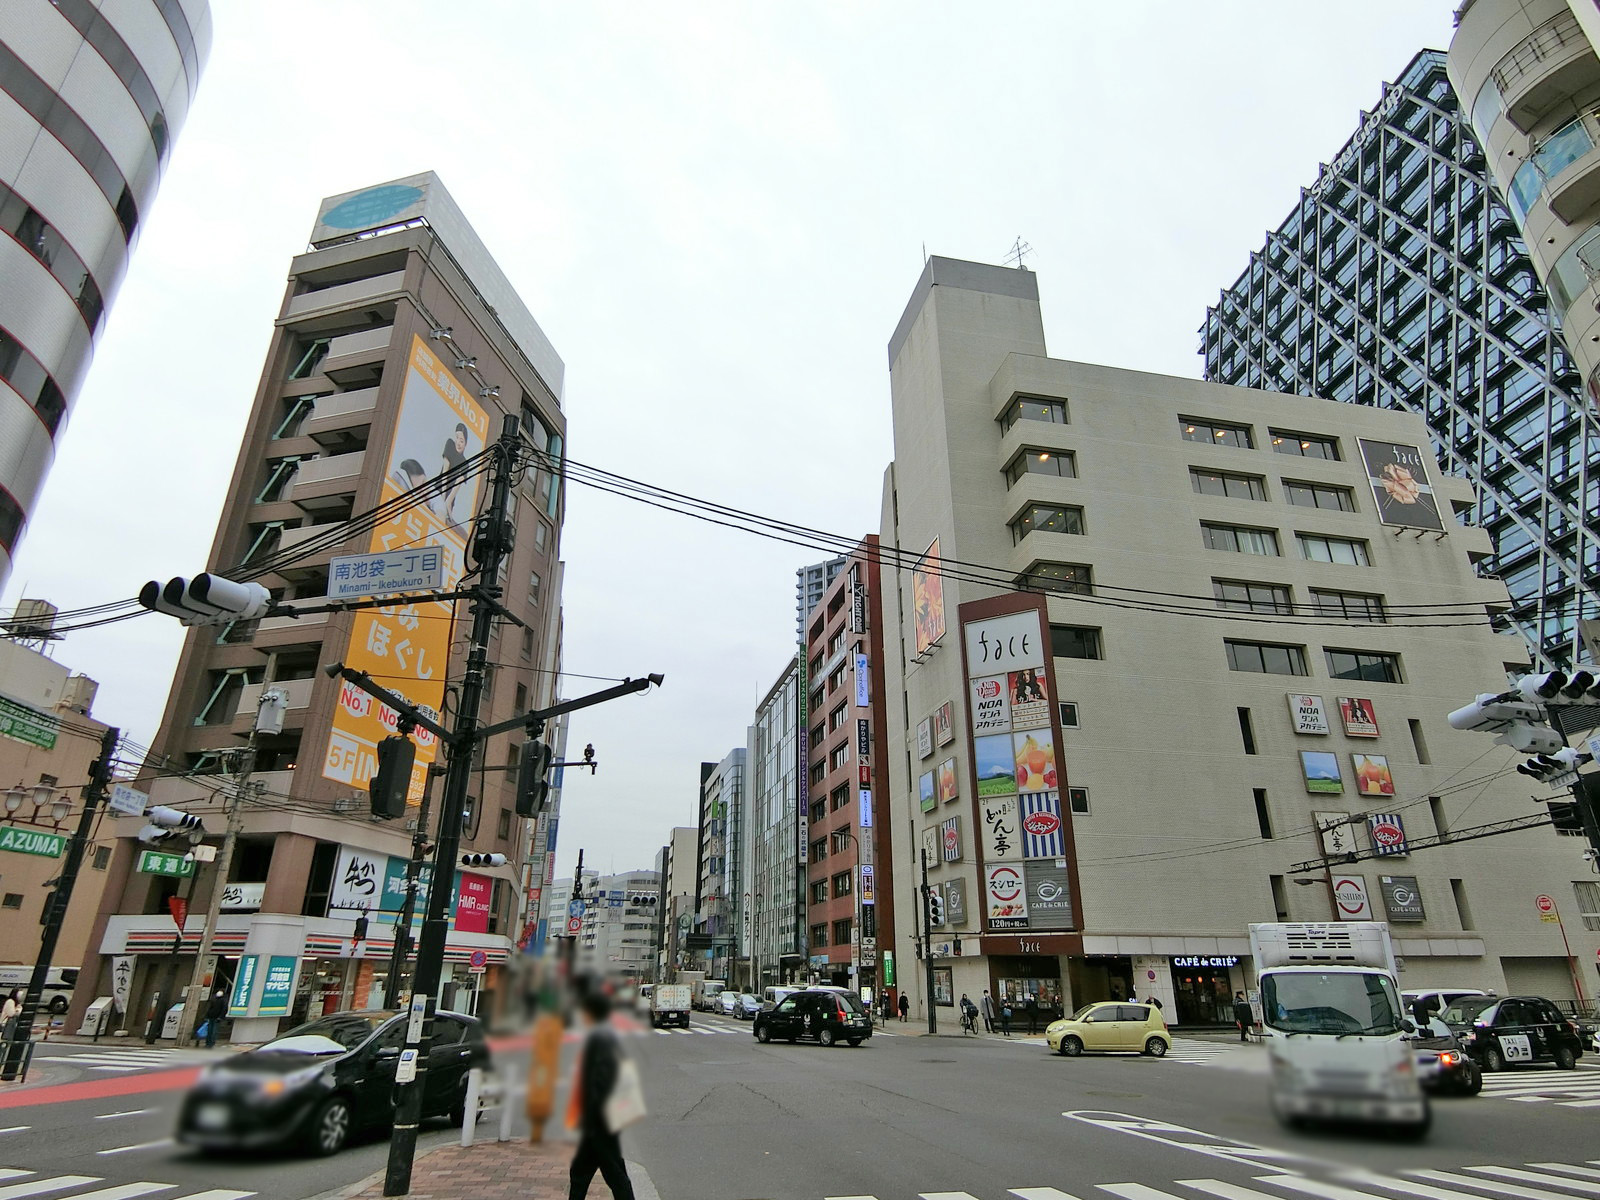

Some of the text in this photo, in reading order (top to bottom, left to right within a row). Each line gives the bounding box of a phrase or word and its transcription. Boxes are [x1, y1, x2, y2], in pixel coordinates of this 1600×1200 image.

[1311, 84, 1404, 201] Seibu Group
[1392, 446, 1420, 466] face
[335, 553, 437, 580] 南池袋一丁目
[338, 575, 432, 594] Minami-Ikebukuro 1
[367, 619, 433, 679] ほぐし
[978, 630, 1029, 662] face
[340, 688, 372, 716] No.1
[978, 699, 1003, 710] NOA
[1299, 707, 1319, 715] NOA
[975, 718, 1009, 730] アカデミー
[1299, 722, 1326, 731] アカデミー
[329, 745, 356, 772] 5F
[986, 808, 1015, 857] どん亭
[1, 830, 60, 855] AZUMA
[149, 856, 192, 874] 東通り
[989, 880, 1023, 890] スシロー
[458, 894, 476, 908] HMR
[1032, 901, 1047, 910] CAFÉ
[1019, 937, 1040, 953] face
[1174, 956, 1199, 966] CAFÉ
[1200, 957, 1209, 966] de
[266, 981, 290, 991] マナビス
